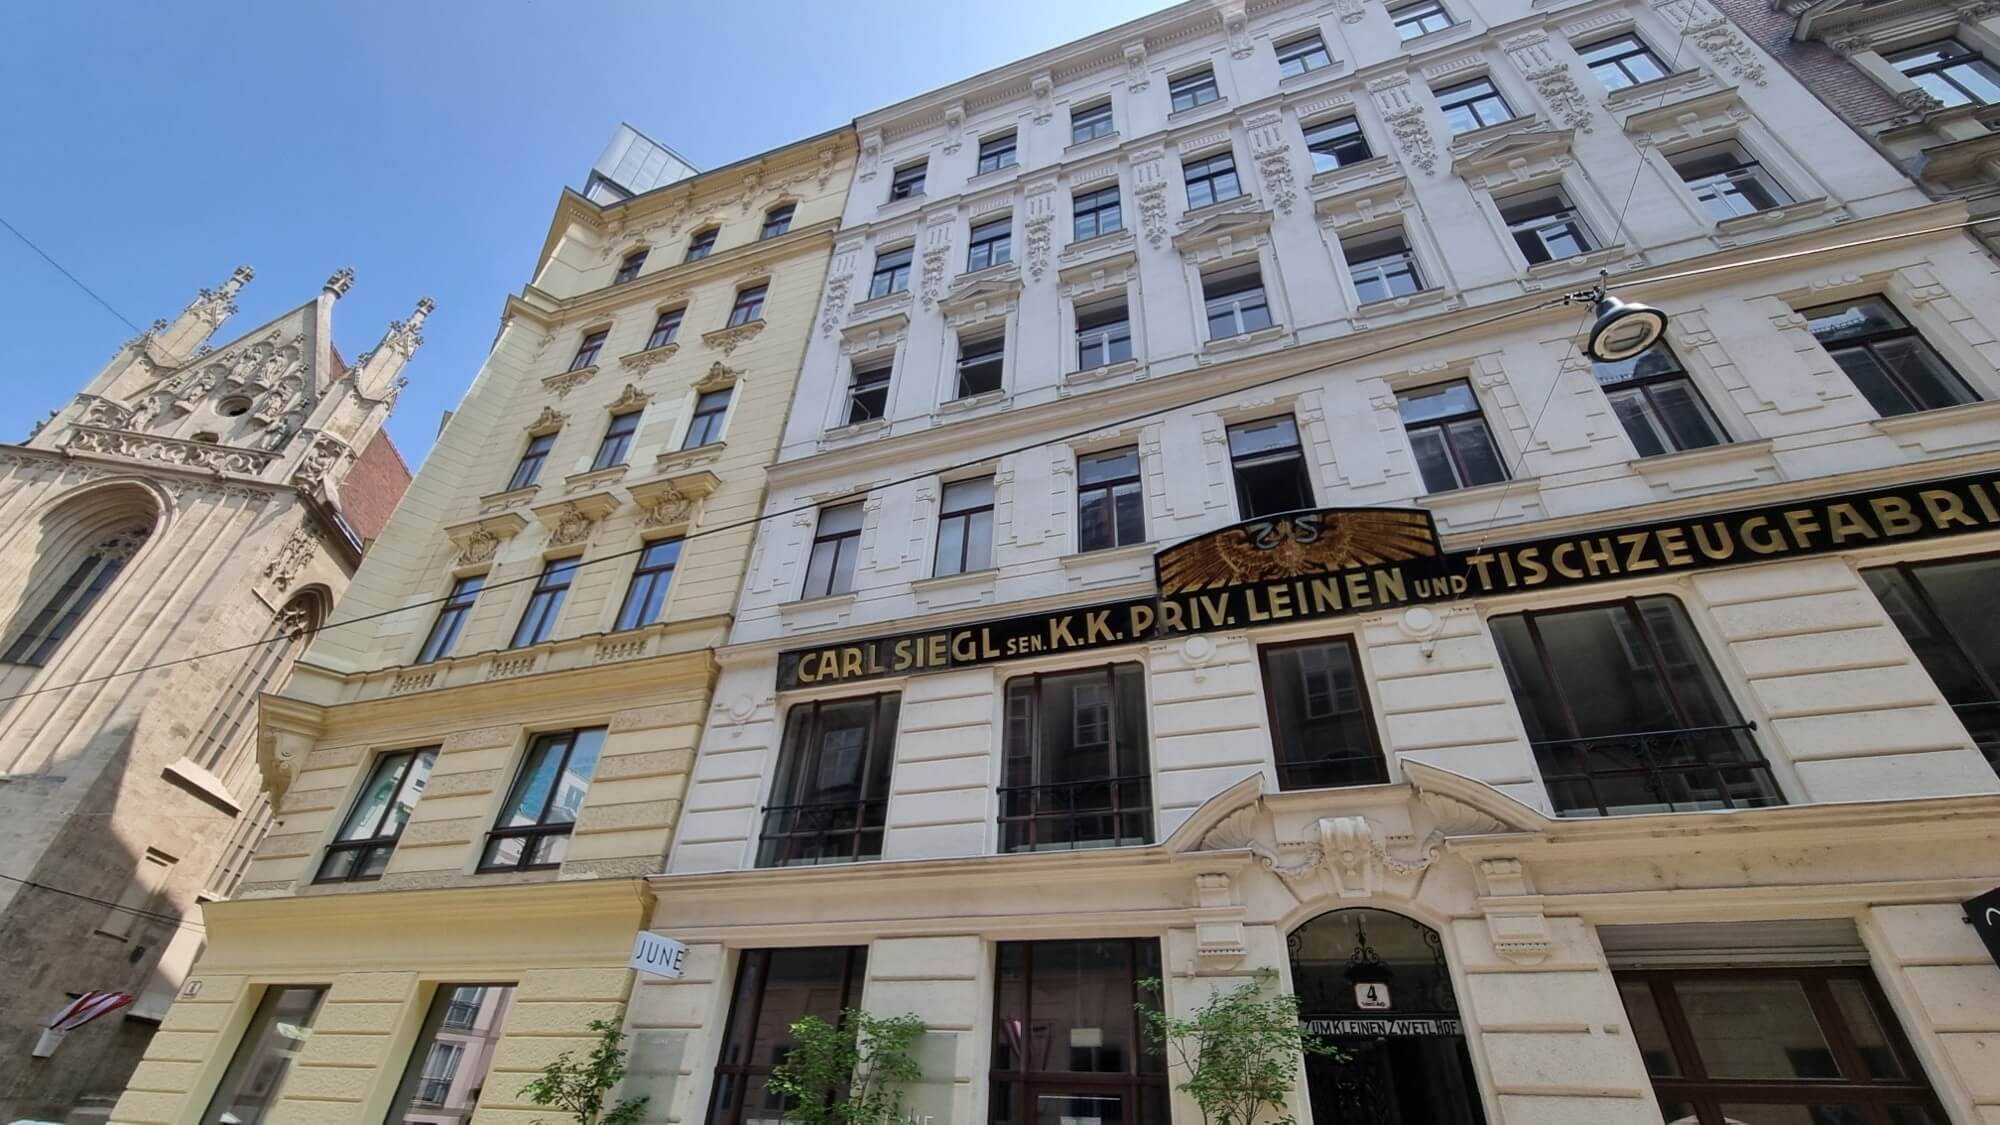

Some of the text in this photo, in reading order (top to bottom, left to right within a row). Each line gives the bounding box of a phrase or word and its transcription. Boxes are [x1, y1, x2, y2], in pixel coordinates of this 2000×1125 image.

[798, 644, 885, 682] CARL
[894, 628, 1001, 671] SIEGL
[1006, 634, 1047, 655] SEN.
[1130, 592, 1236, 636] PRIV.
[1244, 567, 1408, 621] LEINEN
[1414, 575, 1468, 599] UND
[1466, 481, 2000, 590] TISCHZEUGFABRI
[636, 940, 684, 971] JUNE
[1367, 984, 1377, 1001] 4
